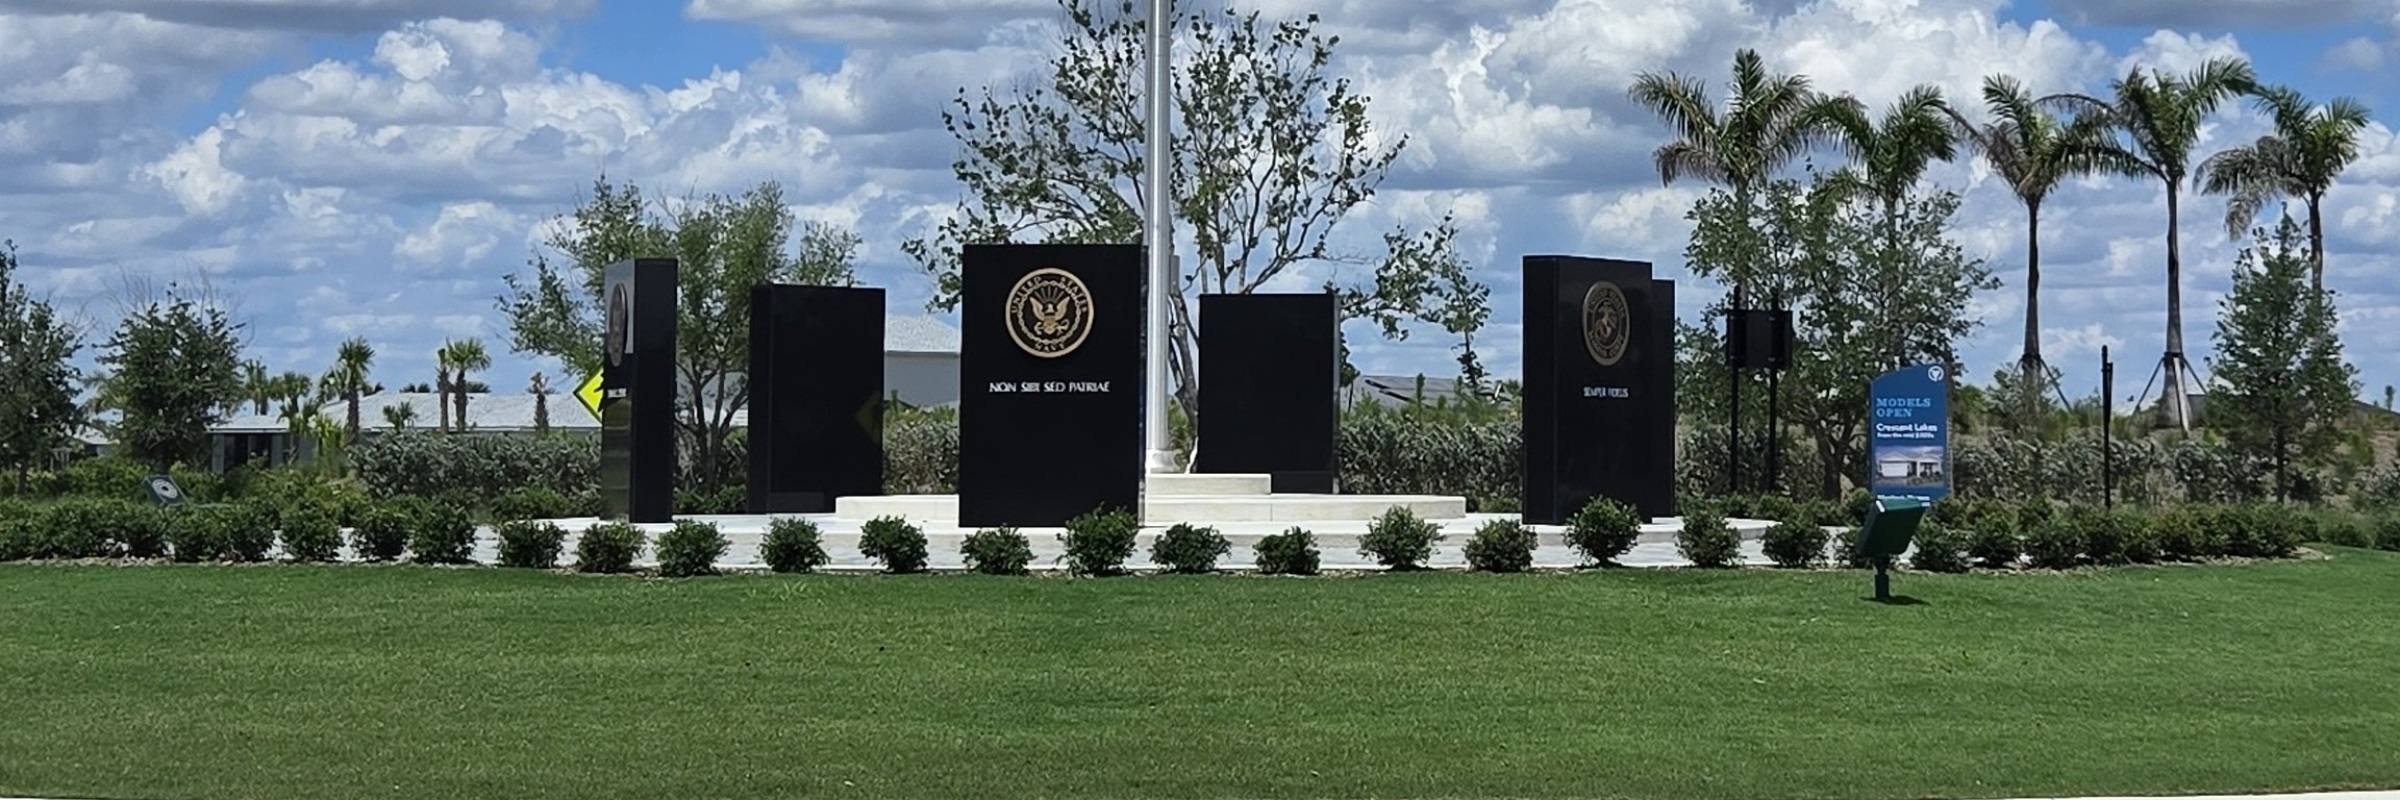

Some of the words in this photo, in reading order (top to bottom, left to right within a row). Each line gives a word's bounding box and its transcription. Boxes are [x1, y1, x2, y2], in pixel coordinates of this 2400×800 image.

[1011, 276, 1041, 313] UNITED
[989, 382, 1017, 392] NON
[1044, 382, 1066, 392] SED
[1069, 381, 1110, 392] PATRIAE
[1876, 398, 1931, 407] MODELS
[1876, 408, 1912, 418] OPEN
[1876, 423, 1913, 432] Crescent
[1914, 423, 1938, 432] Lakes
